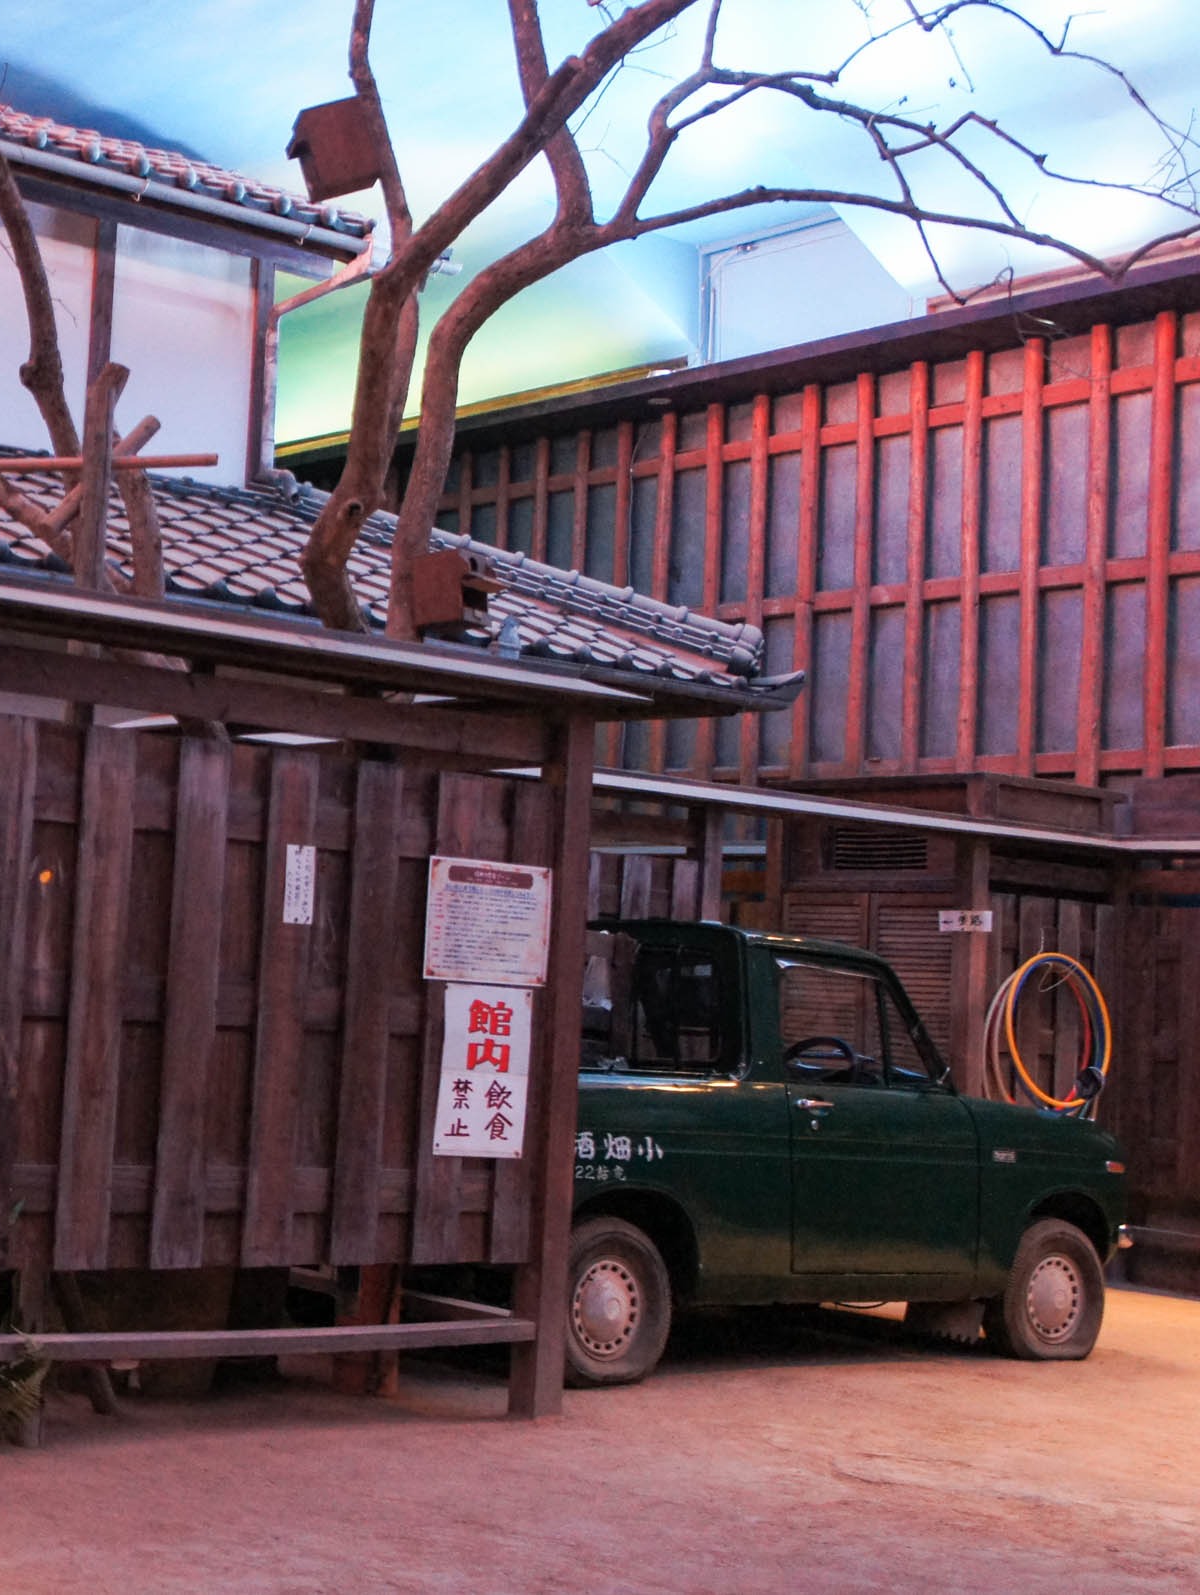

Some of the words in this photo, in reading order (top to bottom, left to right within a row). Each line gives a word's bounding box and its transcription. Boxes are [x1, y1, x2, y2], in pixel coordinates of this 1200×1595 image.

[466, 998, 514, 1073] 館内
[444, 1077, 473, 1137] 禁止
[484, 1079, 513, 1141] 飲食
